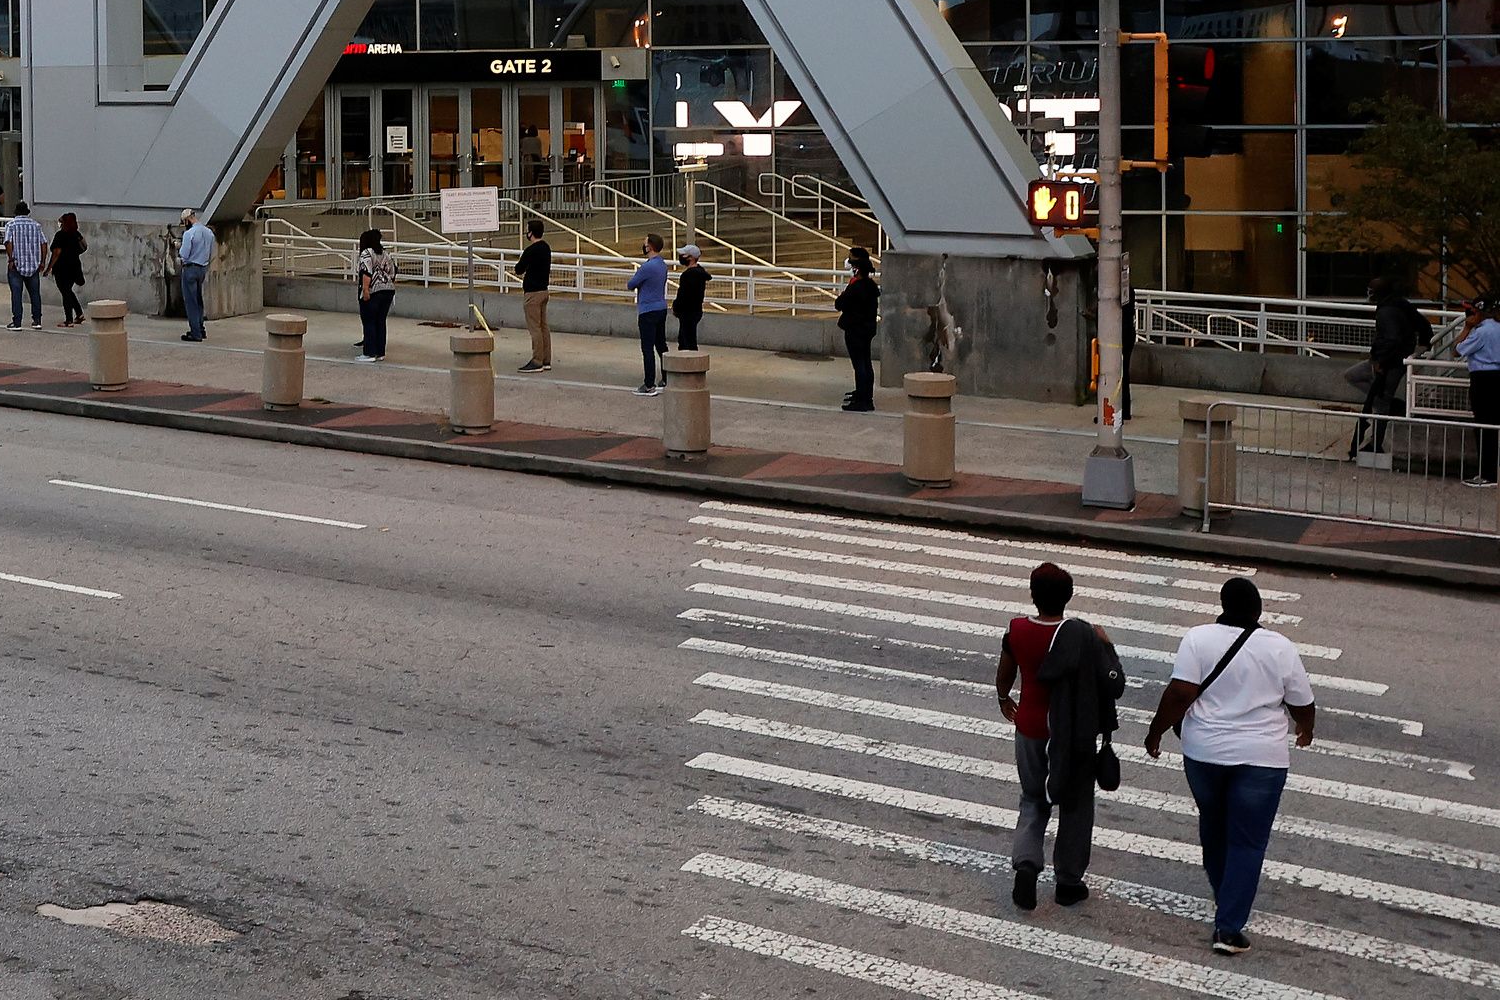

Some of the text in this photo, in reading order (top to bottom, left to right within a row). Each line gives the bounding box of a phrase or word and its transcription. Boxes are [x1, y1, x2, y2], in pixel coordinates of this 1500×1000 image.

[367, 43, 403, 55] ARENA
[490, 59, 552, 74] GATE 2
[1065, 190, 1079, 221] 0
